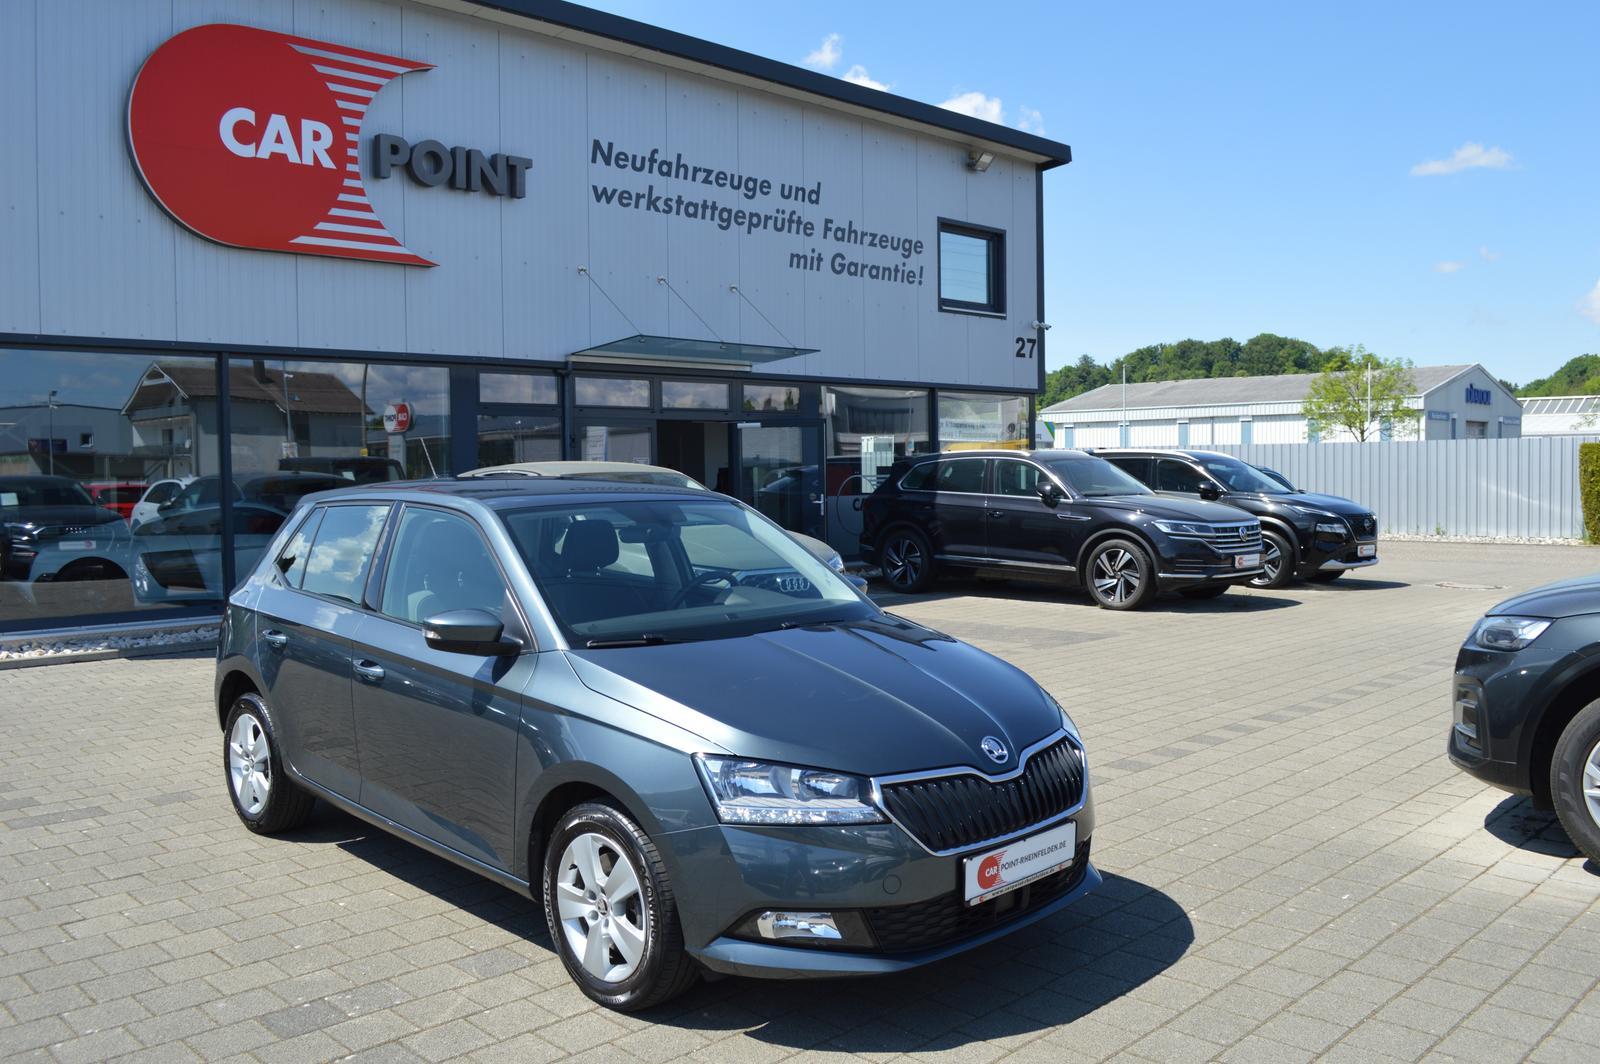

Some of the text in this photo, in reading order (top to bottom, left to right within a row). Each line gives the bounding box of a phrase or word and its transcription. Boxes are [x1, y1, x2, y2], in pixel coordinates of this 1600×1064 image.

[219, 106, 533, 199] CAR POINT
[591, 138, 822, 206] Neufahrzeuge und
[591, 184, 924, 260] werkstattgeprüfte Fahrzeuge
[788, 247, 924, 287] mit Garantie!
[1015, 336, 1037, 359] 27
[985, 841, 1066, 877] CAR POINT-RHEINFELDEN.DE
